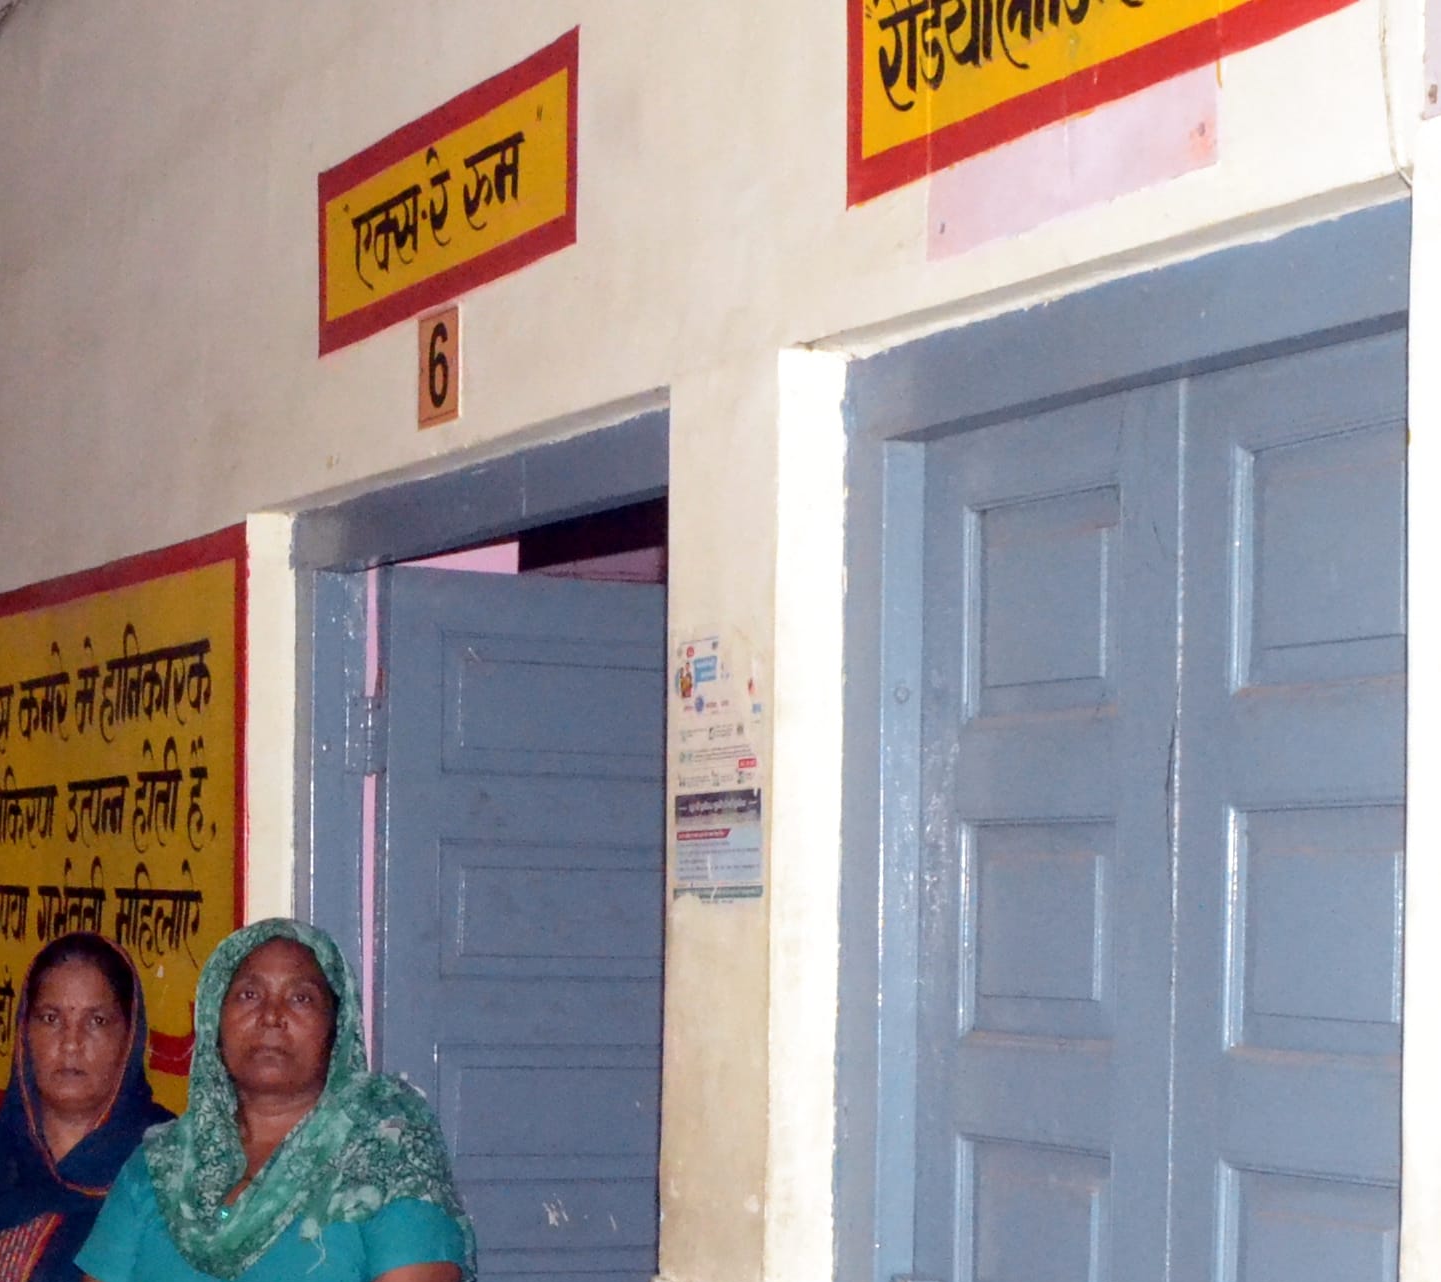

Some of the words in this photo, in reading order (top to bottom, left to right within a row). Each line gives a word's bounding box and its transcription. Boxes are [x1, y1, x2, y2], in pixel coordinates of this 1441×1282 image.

[428, 322, 449, 409] 6
[18, 641, 70, 742] कमरे
[99, 622, 211, 744] हानिकारक
[65, 775, 129, 848] उत्पन्न
[132, 736, 183, 853] होती
